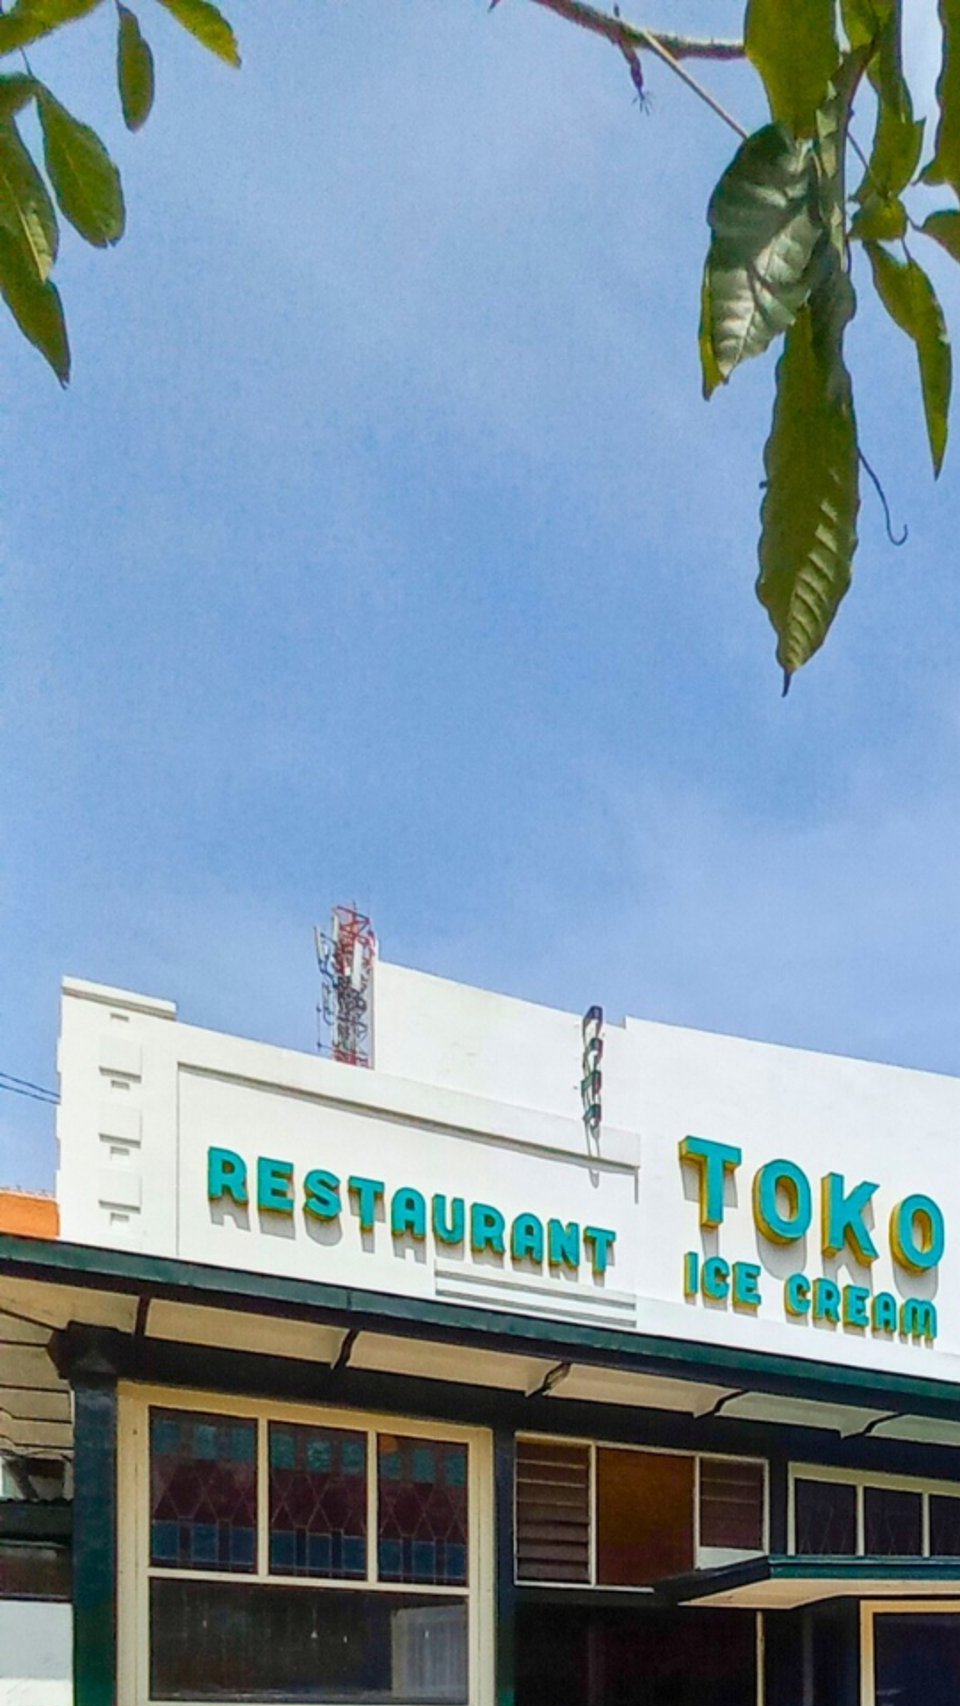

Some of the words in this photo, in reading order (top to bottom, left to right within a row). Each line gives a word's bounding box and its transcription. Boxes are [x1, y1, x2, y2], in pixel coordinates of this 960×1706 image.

[208, 1147, 616, 1276] RESTAURANT
[681, 1136, 945, 1273] TOKO
[684, 1252, 761, 1304] ICE
[785, 1273, 937, 1338] CREAM
